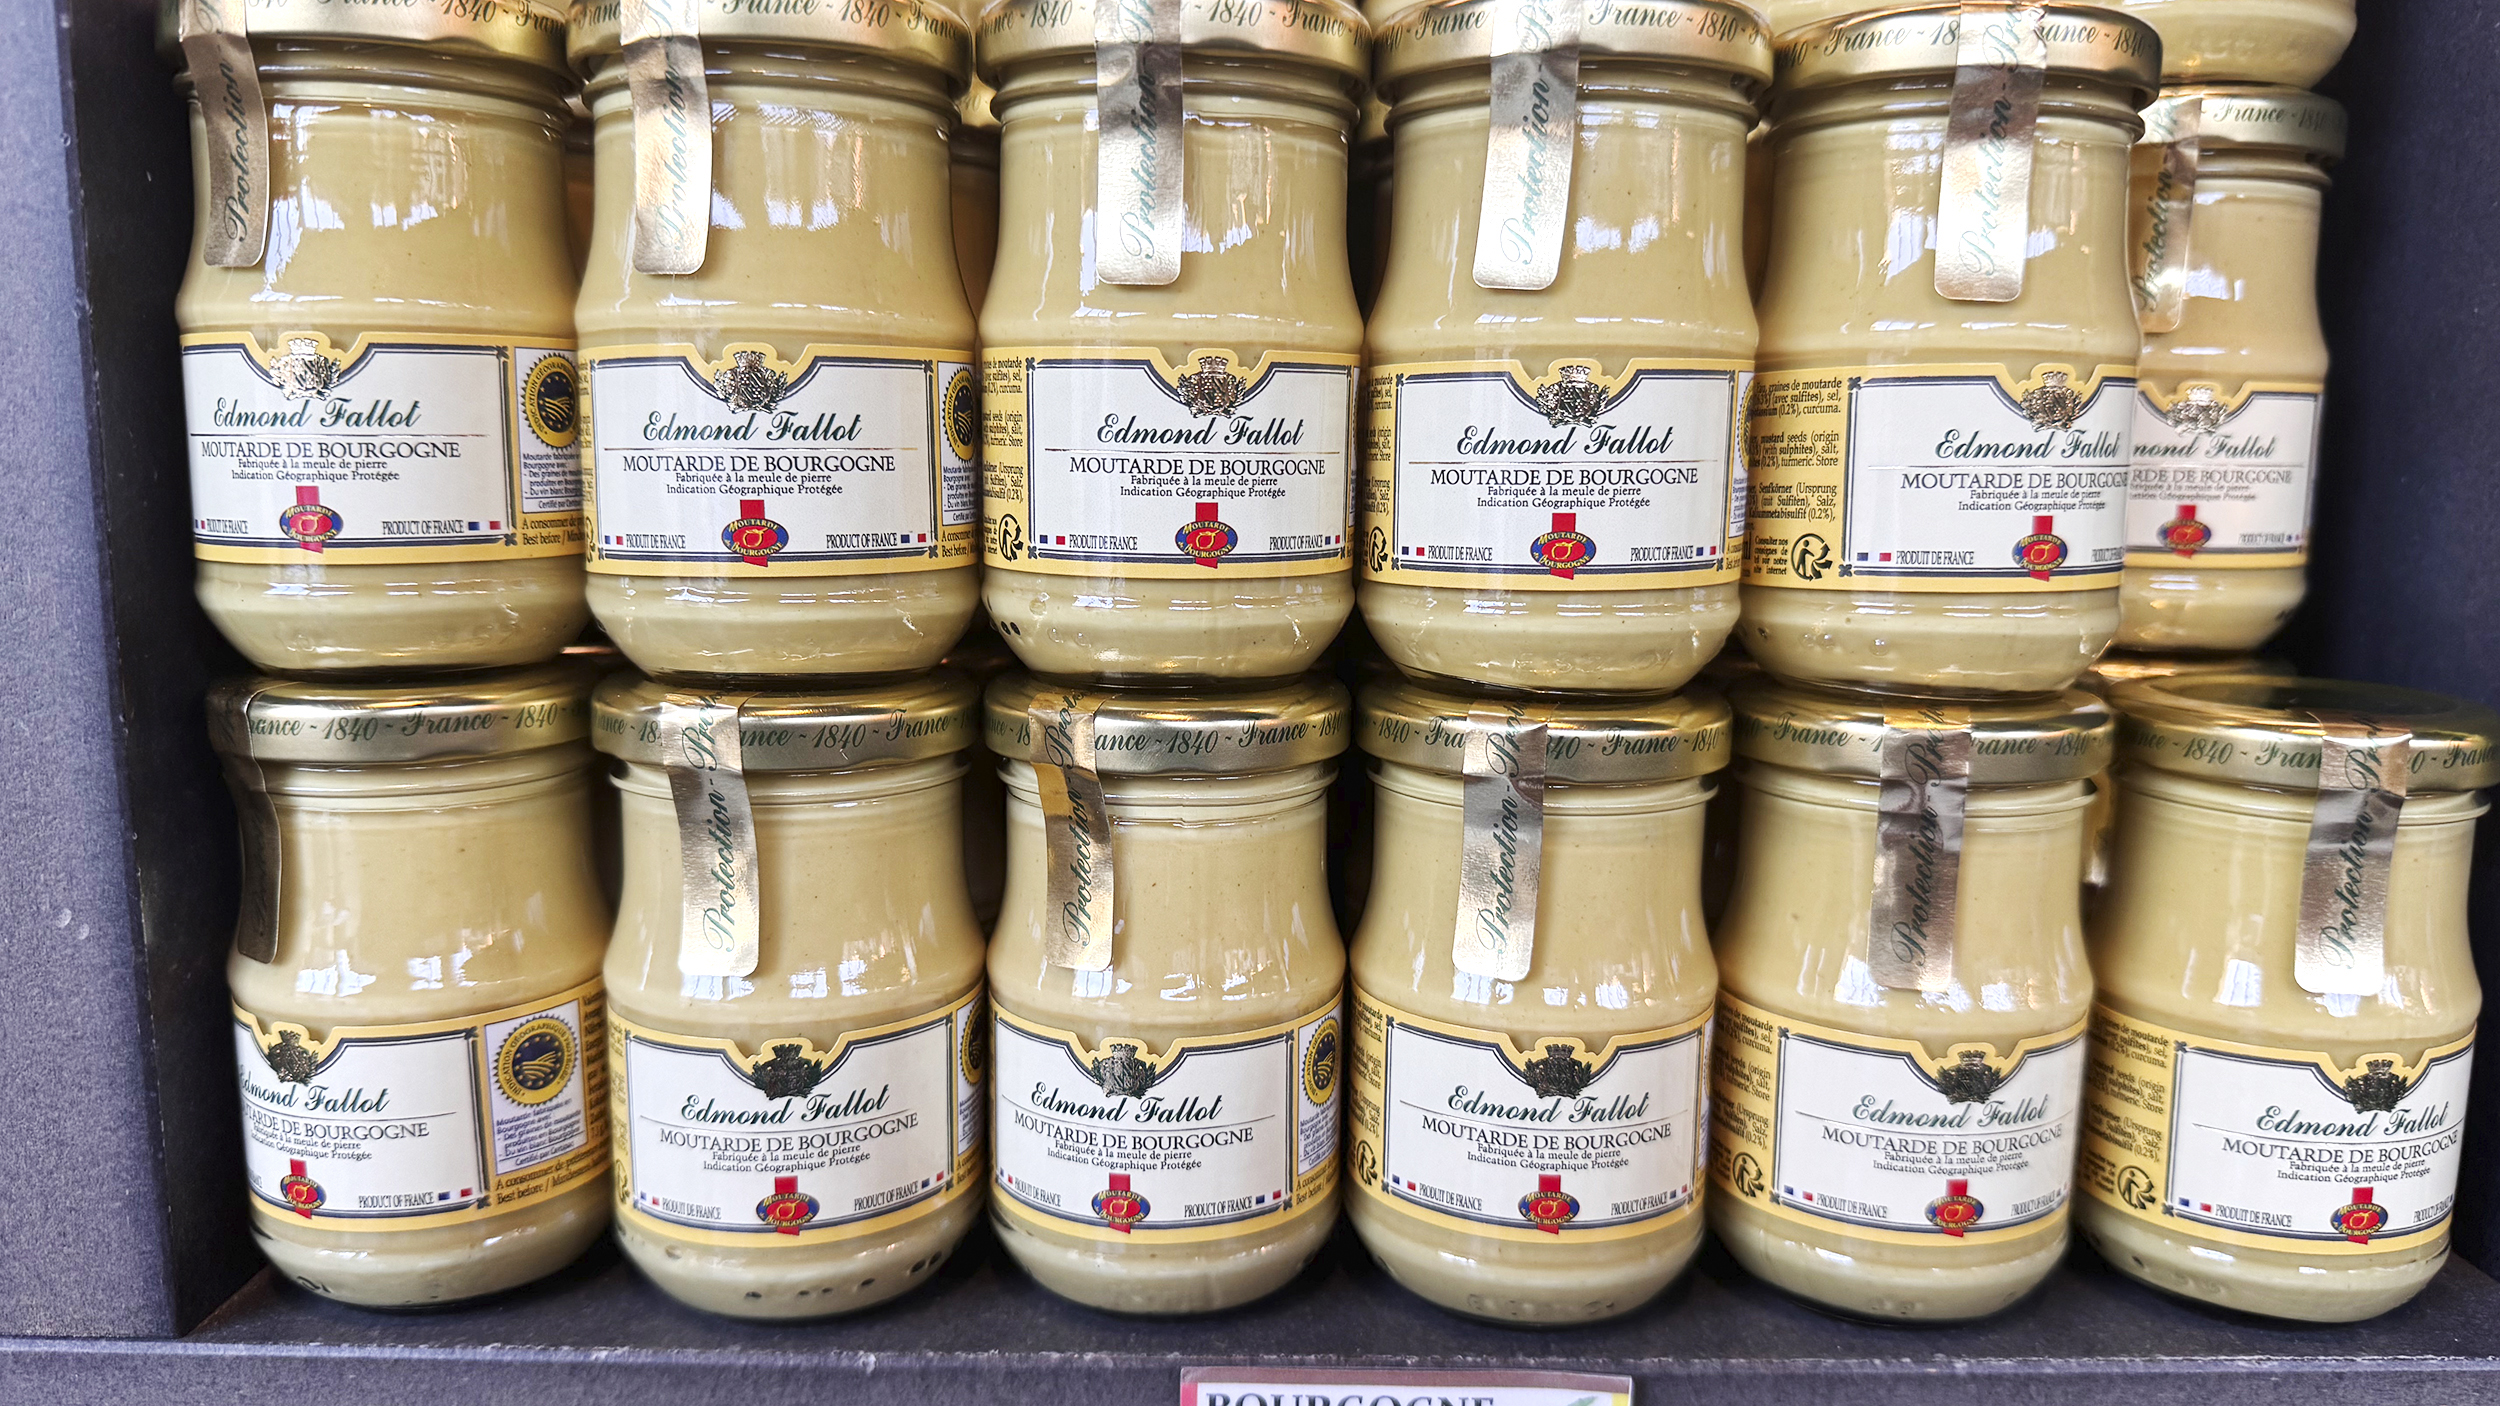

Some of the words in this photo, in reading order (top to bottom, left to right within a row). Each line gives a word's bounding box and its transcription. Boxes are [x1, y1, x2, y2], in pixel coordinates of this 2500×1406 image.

[441, 0, 497, 23] 1840
[839, 0, 890, 28] 1840
[1030, 0, 1072, 28] 1840
[1206, 0, 1262, 28] 1840
[1283, 1, 1346, 37] France
[1414, 7, 1490, 41] France
[1588, 2, 1681, 28] France
[1697, 13, 1738, 43] 1840
[1823, 25, 1912, 57] France
[2213, 103, 2287, 123] France
[223, 59, 249, 243] Protection
[655, 65, 688, 253] Protection
[1119, 72, 1156, 260] Protection
[1501, 79, 1552, 266] Protection
[1959, 99, 2012, 277] Protection
[1790, 391, 1825, 404] sulfites),
[1827, 389, 1841, 402] sel,
[1791, 379, 1800, 391] de
[1802, 377, 1842, 391] moutarde
[214, 396, 312, 427] Edmond
[320, 397, 421, 427] Fallot
[1803, 403, 1841, 414] curcuma.
[643, 410, 759, 441] Edmond
[766, 410, 863, 441] Fallot
[1097, 413, 1218, 445] Edmond
[1223, 415, 1305, 445] Fallot
[1456, 425, 1578, 455] Edmond
[1584, 425, 1674, 455] Fallot
[1787, 431, 1807, 442] seeds
[1811, 430, 1839, 446] (origin
[201, 441, 282, 458] MOUTARDE
[287, 442, 312, 458] DE
[318, 442, 461, 458] BOURGOGNE
[1779, 444, 1818, 457] sulphites),
[1821, 442, 1839, 455] salt,
[1934, 428, 2055, 459] Edmond
[2060, 429, 2120, 459] Fallot
[2205, 434, 2277, 459] Fallot
[623, 455, 727, 472] MOUTARDE
[730, 456, 760, 472] DE
[766, 456, 896, 473] BOURGOGNE
[1069, 457, 1183, 475] MOUTARDE
[1188, 460, 1215, 475] DE
[1219, 460, 1325, 475] BOURGOGNE
[1816, 455, 1838, 466] Store
[666, 484, 716, 495] Indication
[719, 484, 795, 497] Géographique
[797, 484, 843, 497] Protégée
[1131, 475, 1181, 488] Fabriquée
[1192, 476, 1201, 486] la
[1204, 477, 1236, 486] meule
[1238, 477, 1249, 486] de
[1251, 478, 1278, 488] pierre
[1430, 469, 1541, 485] MOUTARDE
[1546, 469, 1575, 485] DE
[1579, 468, 1699, 485] BOURGOGNE
[1796, 482, 1837, 498] (Ursprung
[1900, 473, 2023, 489] MOUTARDE
[2027, 473, 2052, 489] DE
[2172, 470, 2196, 483] DE
[2200, 470, 2292, 484] BOURGOGNE
[1120, 486, 1173, 497] Indication
[1175, 486, 1246, 499] Géographique
[1248, 487, 1286, 498] Protégée
[1477, 497, 1529, 508] Indication
[1532, 497, 1606, 510] Géographique
[1608, 497, 1650, 509] Protégée
[1817, 494, 1836, 509] Salz,
[522, 533, 538, 545] Best
[1069, 534, 1097, 549] PRODUIT
[1099, 535, 1108, 549] DE
[1109, 536, 1138, 550] FRANCE
[1269, 536, 1297, 551] PRODUCT
[1297, 535, 1306, 549] OF
[1306, 534, 1323, 549] FRANCE
[322, 717, 379, 741] 1840
[400, 710, 496, 736] France
[514, 703, 558, 730] 1840
[811, 723, 866, 750] 1840
[885, 709, 951, 742] France
[1166, 730, 1220, 755] 1840
[1238, 719, 1310, 748] France
[1376, 717, 1411, 744] 1840
[1773, 711, 1854, 747] France
[1601, 728, 1681, 756] France
[1690, 726, 1721, 752] 1840
[2054, 730, 2088, 757] 1840
[2181, 736, 2235, 765] 1840
[2255, 739, 2322, 769] Fran
[702, 786, 734, 953] Protection
[1062, 788, 1092, 947] Protection
[1475, 794, 1519, 954] Protection
[1891, 807, 1940, 967] Protection
[2319, 811, 2374, 971] Protection
[305, 1085, 390, 1113] Fallot
[680, 1094, 794, 1125] Edmond
[800, 1084, 890, 1121] Fallot
[1031, 1081, 1128, 1122] Edmond
[1134, 1095, 1223, 1123] Fallot
[1447, 1084, 1562, 1123] Edmond
[1568, 1092, 1650, 1123] Fallot
[1852, 1094, 1971, 1128] Edmond
[1976, 1094, 2048, 1128] Fallot
[282, 1118, 301, 1136] DE
[305, 1123, 430, 1140] BOURGOGNE
[660, 1128, 762, 1152] MOUTARDE
[766, 1137, 793, 1152] DE
[798, 1113, 919, 1150] BOURGOGNE
[1014, 1109, 1098, 1147] MOUTARDE
[1102, 1134, 1128, 1149] DE
[1132, 1128, 1254, 1150] BOURGOGNE
[1422, 1115, 1529, 1148] MOUTARDE
[1532, 1135, 1560, 1150] DE
[1564, 1123, 1672, 1150] BOURGOGNE
[2255, 1105, 2379, 1137] Edmond
[2383, 1101, 2449, 1136] Fallot
[1055, 1139, 1096, 1156] Fabriquée
[1106, 1149, 1115, 1158] la
[1117, 1149, 1147, 1160] meule
[1149, 1150, 1161, 1160] de
[1163, 1150, 1192, 1162] pierre
[1821, 1125, 1937, 1155] MOUTARDE
[1941, 1140, 1968, 1155] DE
[1972, 1123, 2062, 1155] BOURGOGNE
[2221, 1137, 2343, 1163] MOUTARDE
[2350, 1149, 2372, 1163] DE
[2378, 1130, 2459, 1163] BOURGOGNE
[703, 1160, 752, 1172] Indication
[754, 1160, 826, 1174] Géographique
[828, 1152, 870, 1166] Protégée
[1419, 1182, 1446, 1203] PRODUIT
[1446, 1190, 1455, 1204] DE
[1455, 1192, 1482, 1211] FRANCE
